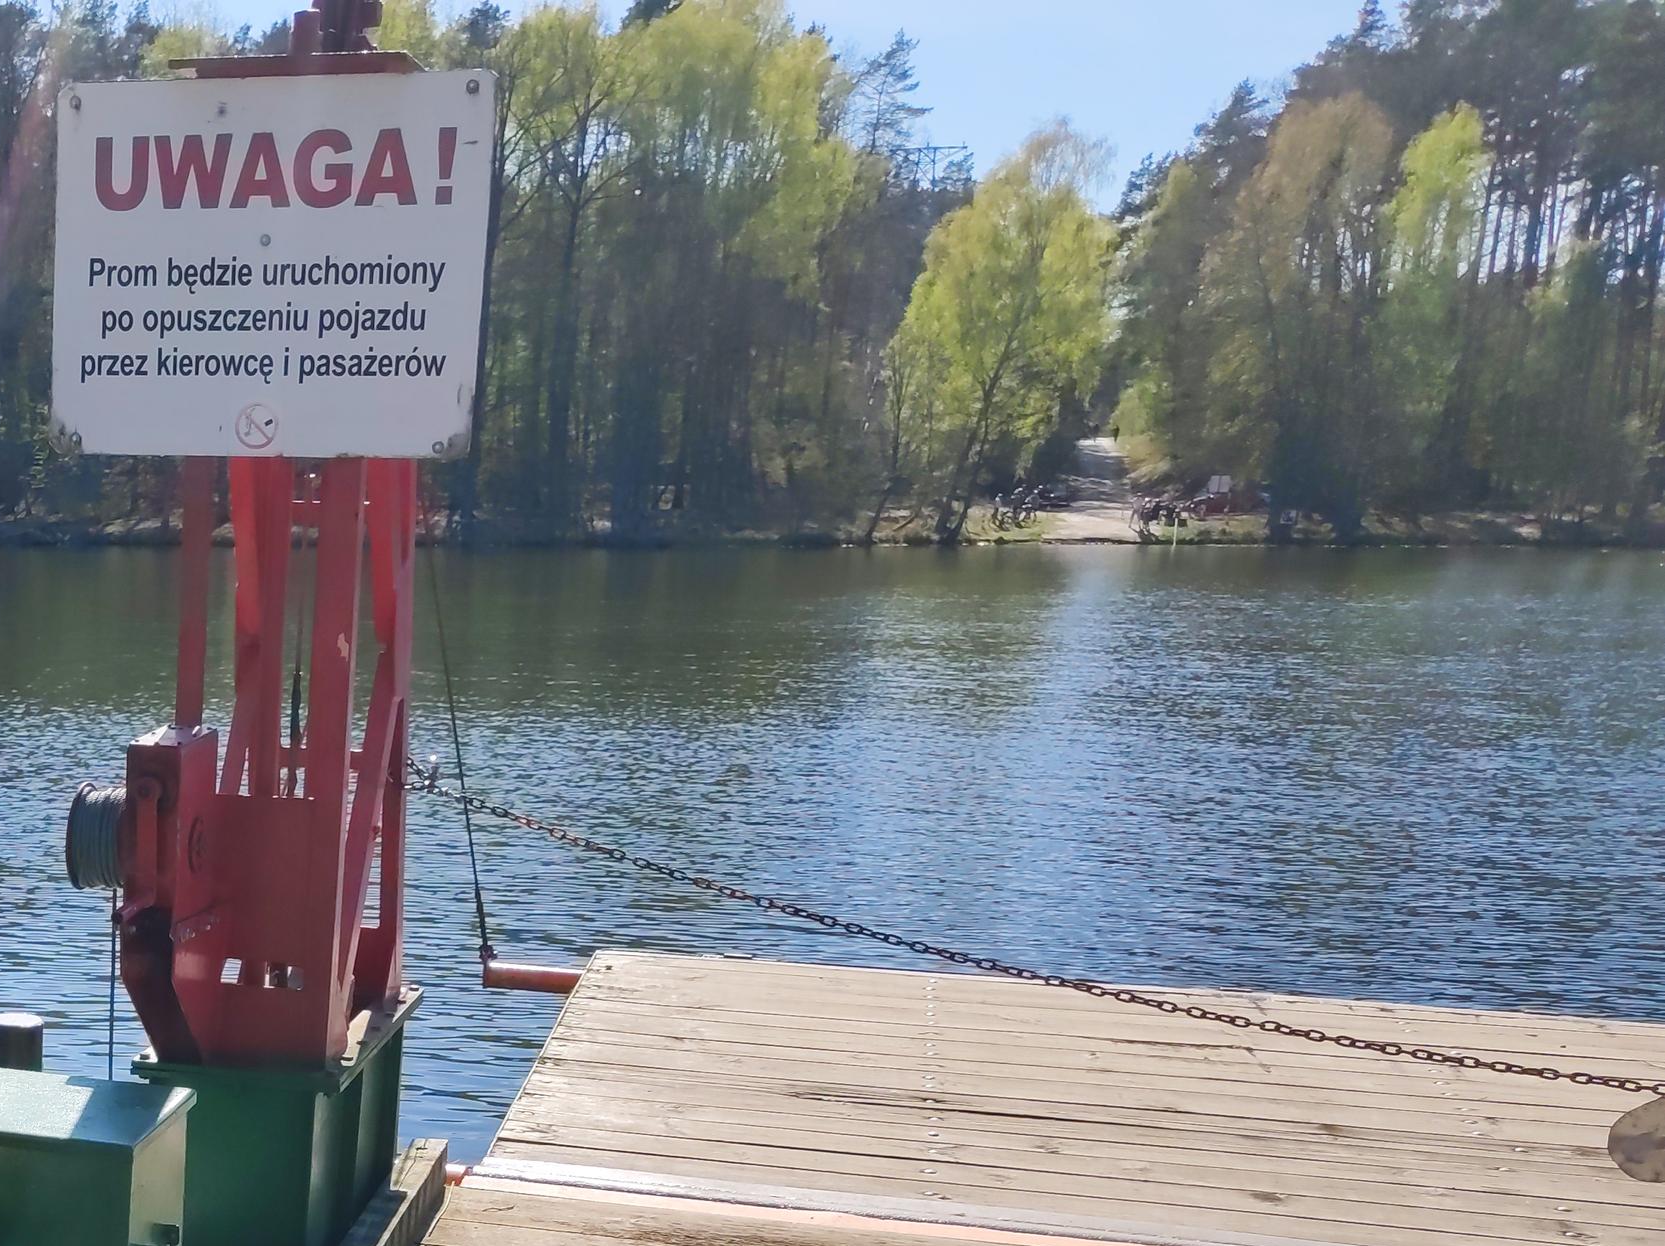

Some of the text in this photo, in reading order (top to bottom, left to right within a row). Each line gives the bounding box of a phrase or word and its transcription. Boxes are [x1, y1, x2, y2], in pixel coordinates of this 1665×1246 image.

[88, 255, 446, 294] Prom będzie uruchomiony
[101, 302, 426, 339] po opuszczeniu pojazdu
[80, 347, 446, 383] przez kierowcę i pasażerów
